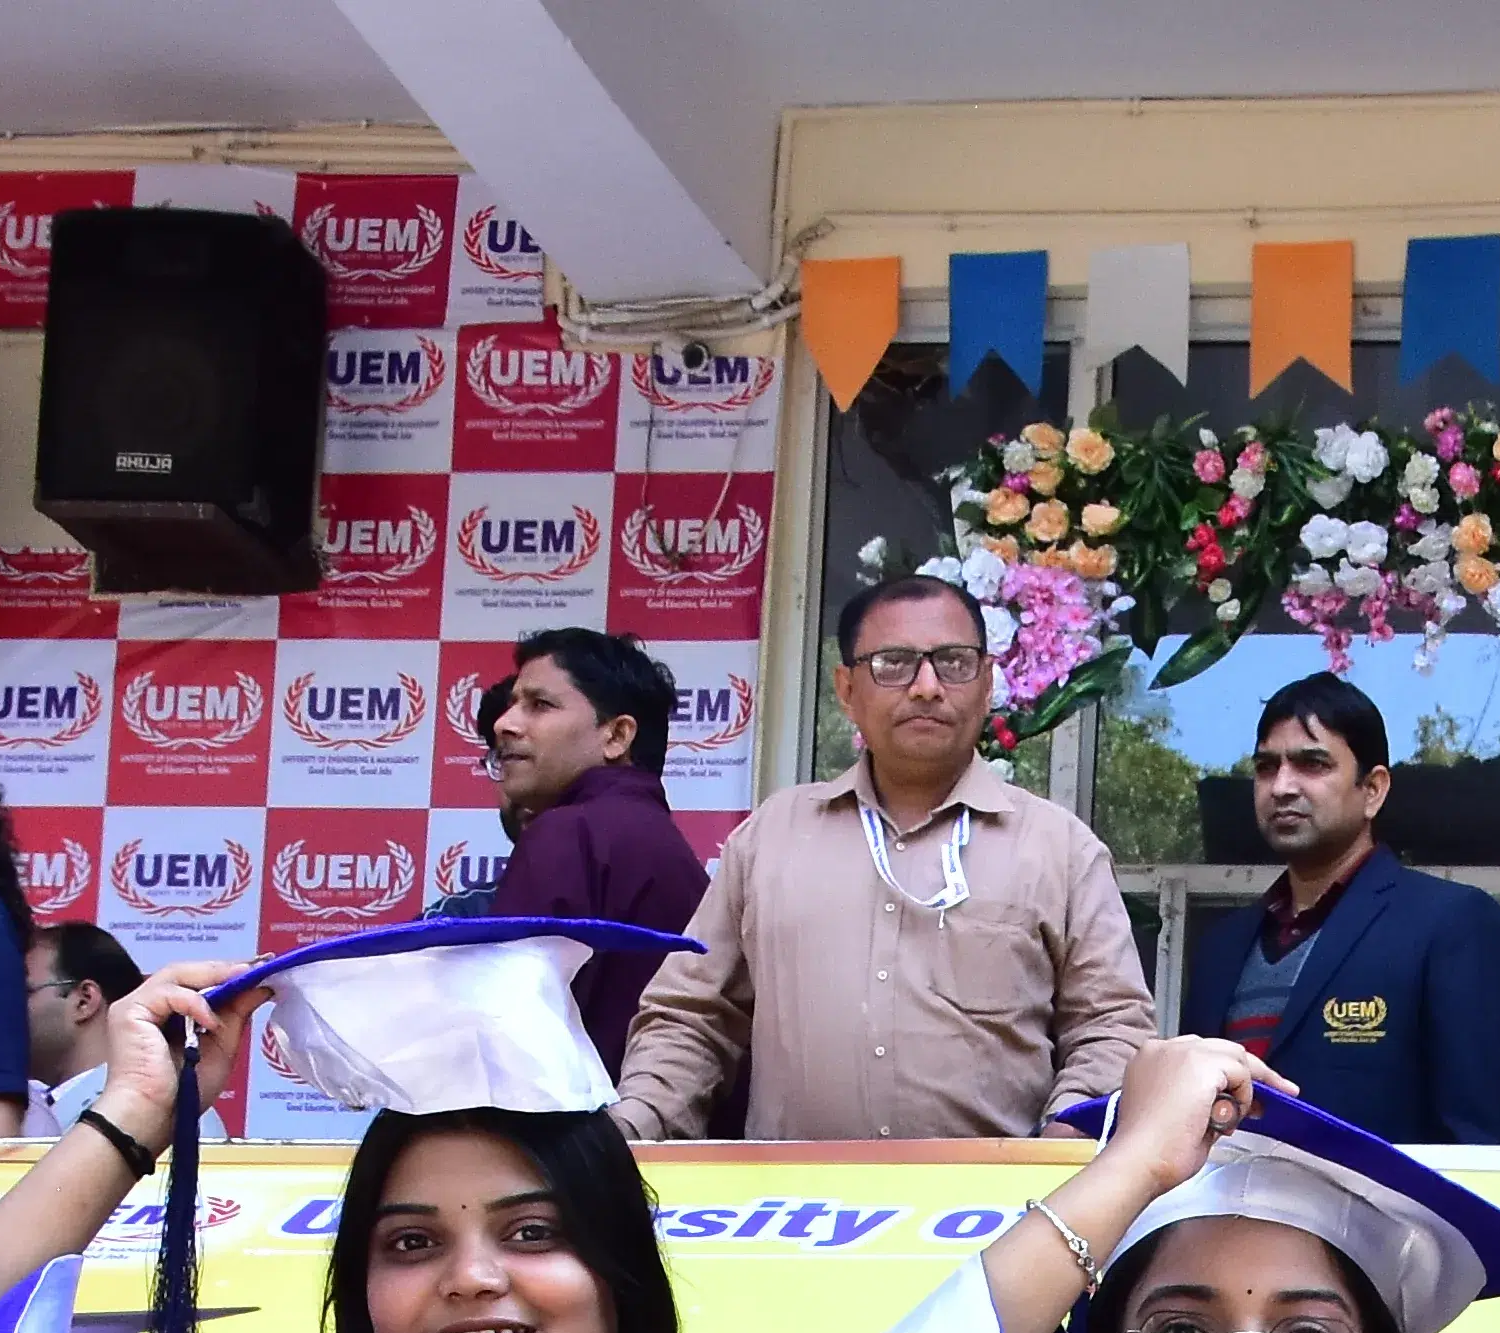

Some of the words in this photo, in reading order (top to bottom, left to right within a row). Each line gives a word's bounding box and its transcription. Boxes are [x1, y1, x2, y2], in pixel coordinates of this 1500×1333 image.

[6, 216, 52, 249] UE
[326, 218, 419, 251] UEM
[488, 220, 541, 253] UE
[328, 352, 420, 385] UEM
[490, 352, 583, 385] UEM
[116, 456, 172, 471] AHUJA
[482, 520, 575, 553] UEM
[146, 687, 238, 720] UEM
[308, 688, 400, 720] UEM
[670, 690, 731, 722] EM
[135, 854, 227, 887] UEM
[297, 855, 390, 889] UEM
[1334, 1002, 1375, 1017] UEM
